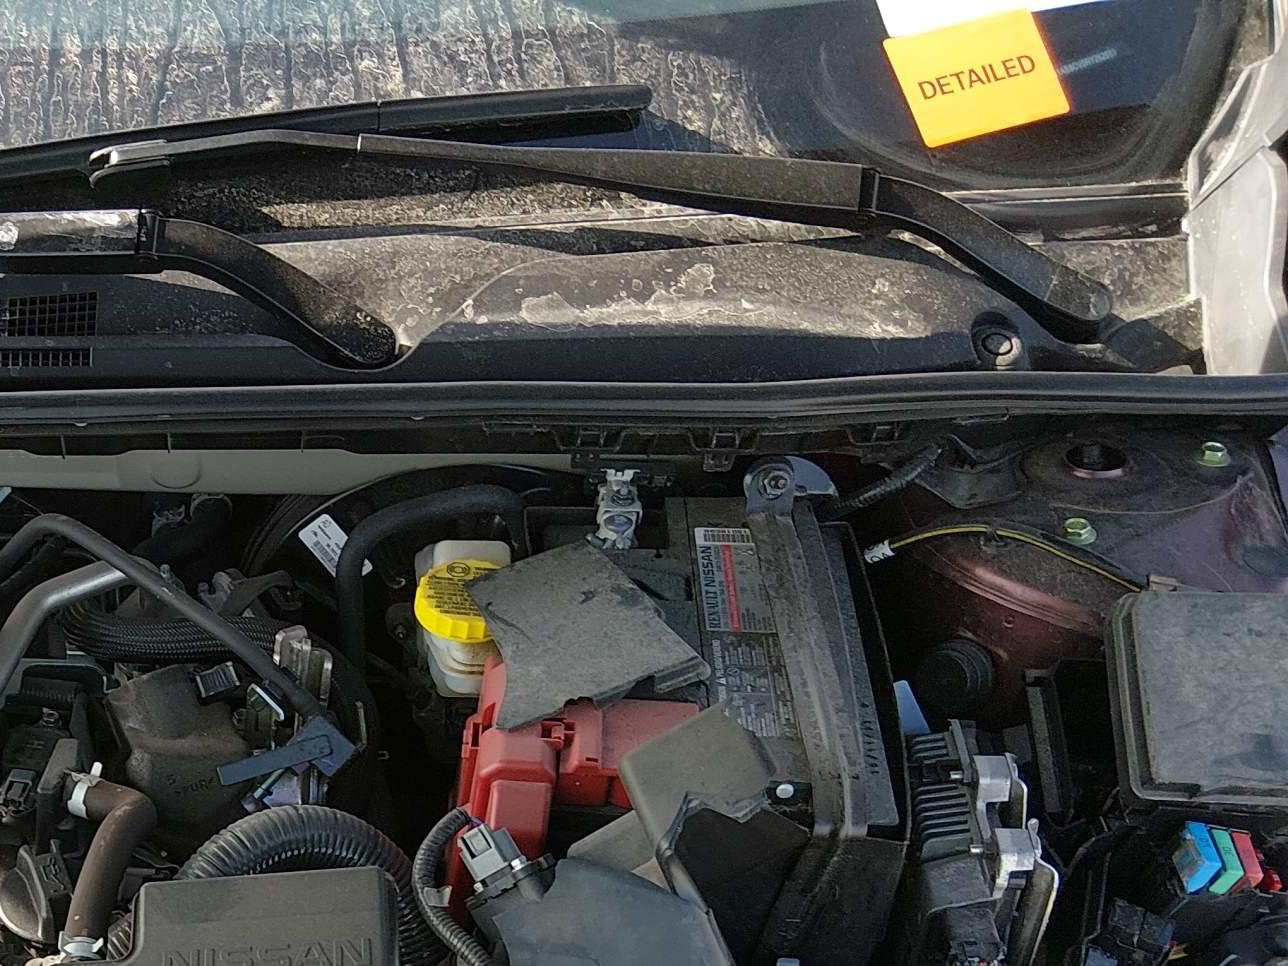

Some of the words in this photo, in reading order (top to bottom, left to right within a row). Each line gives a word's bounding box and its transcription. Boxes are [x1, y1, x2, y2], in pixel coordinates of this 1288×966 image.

[917, 54, 1037, 101] DETAILED
[699, 545, 716, 587] NISSAN
[705, 588, 721, 629] RENAULT
